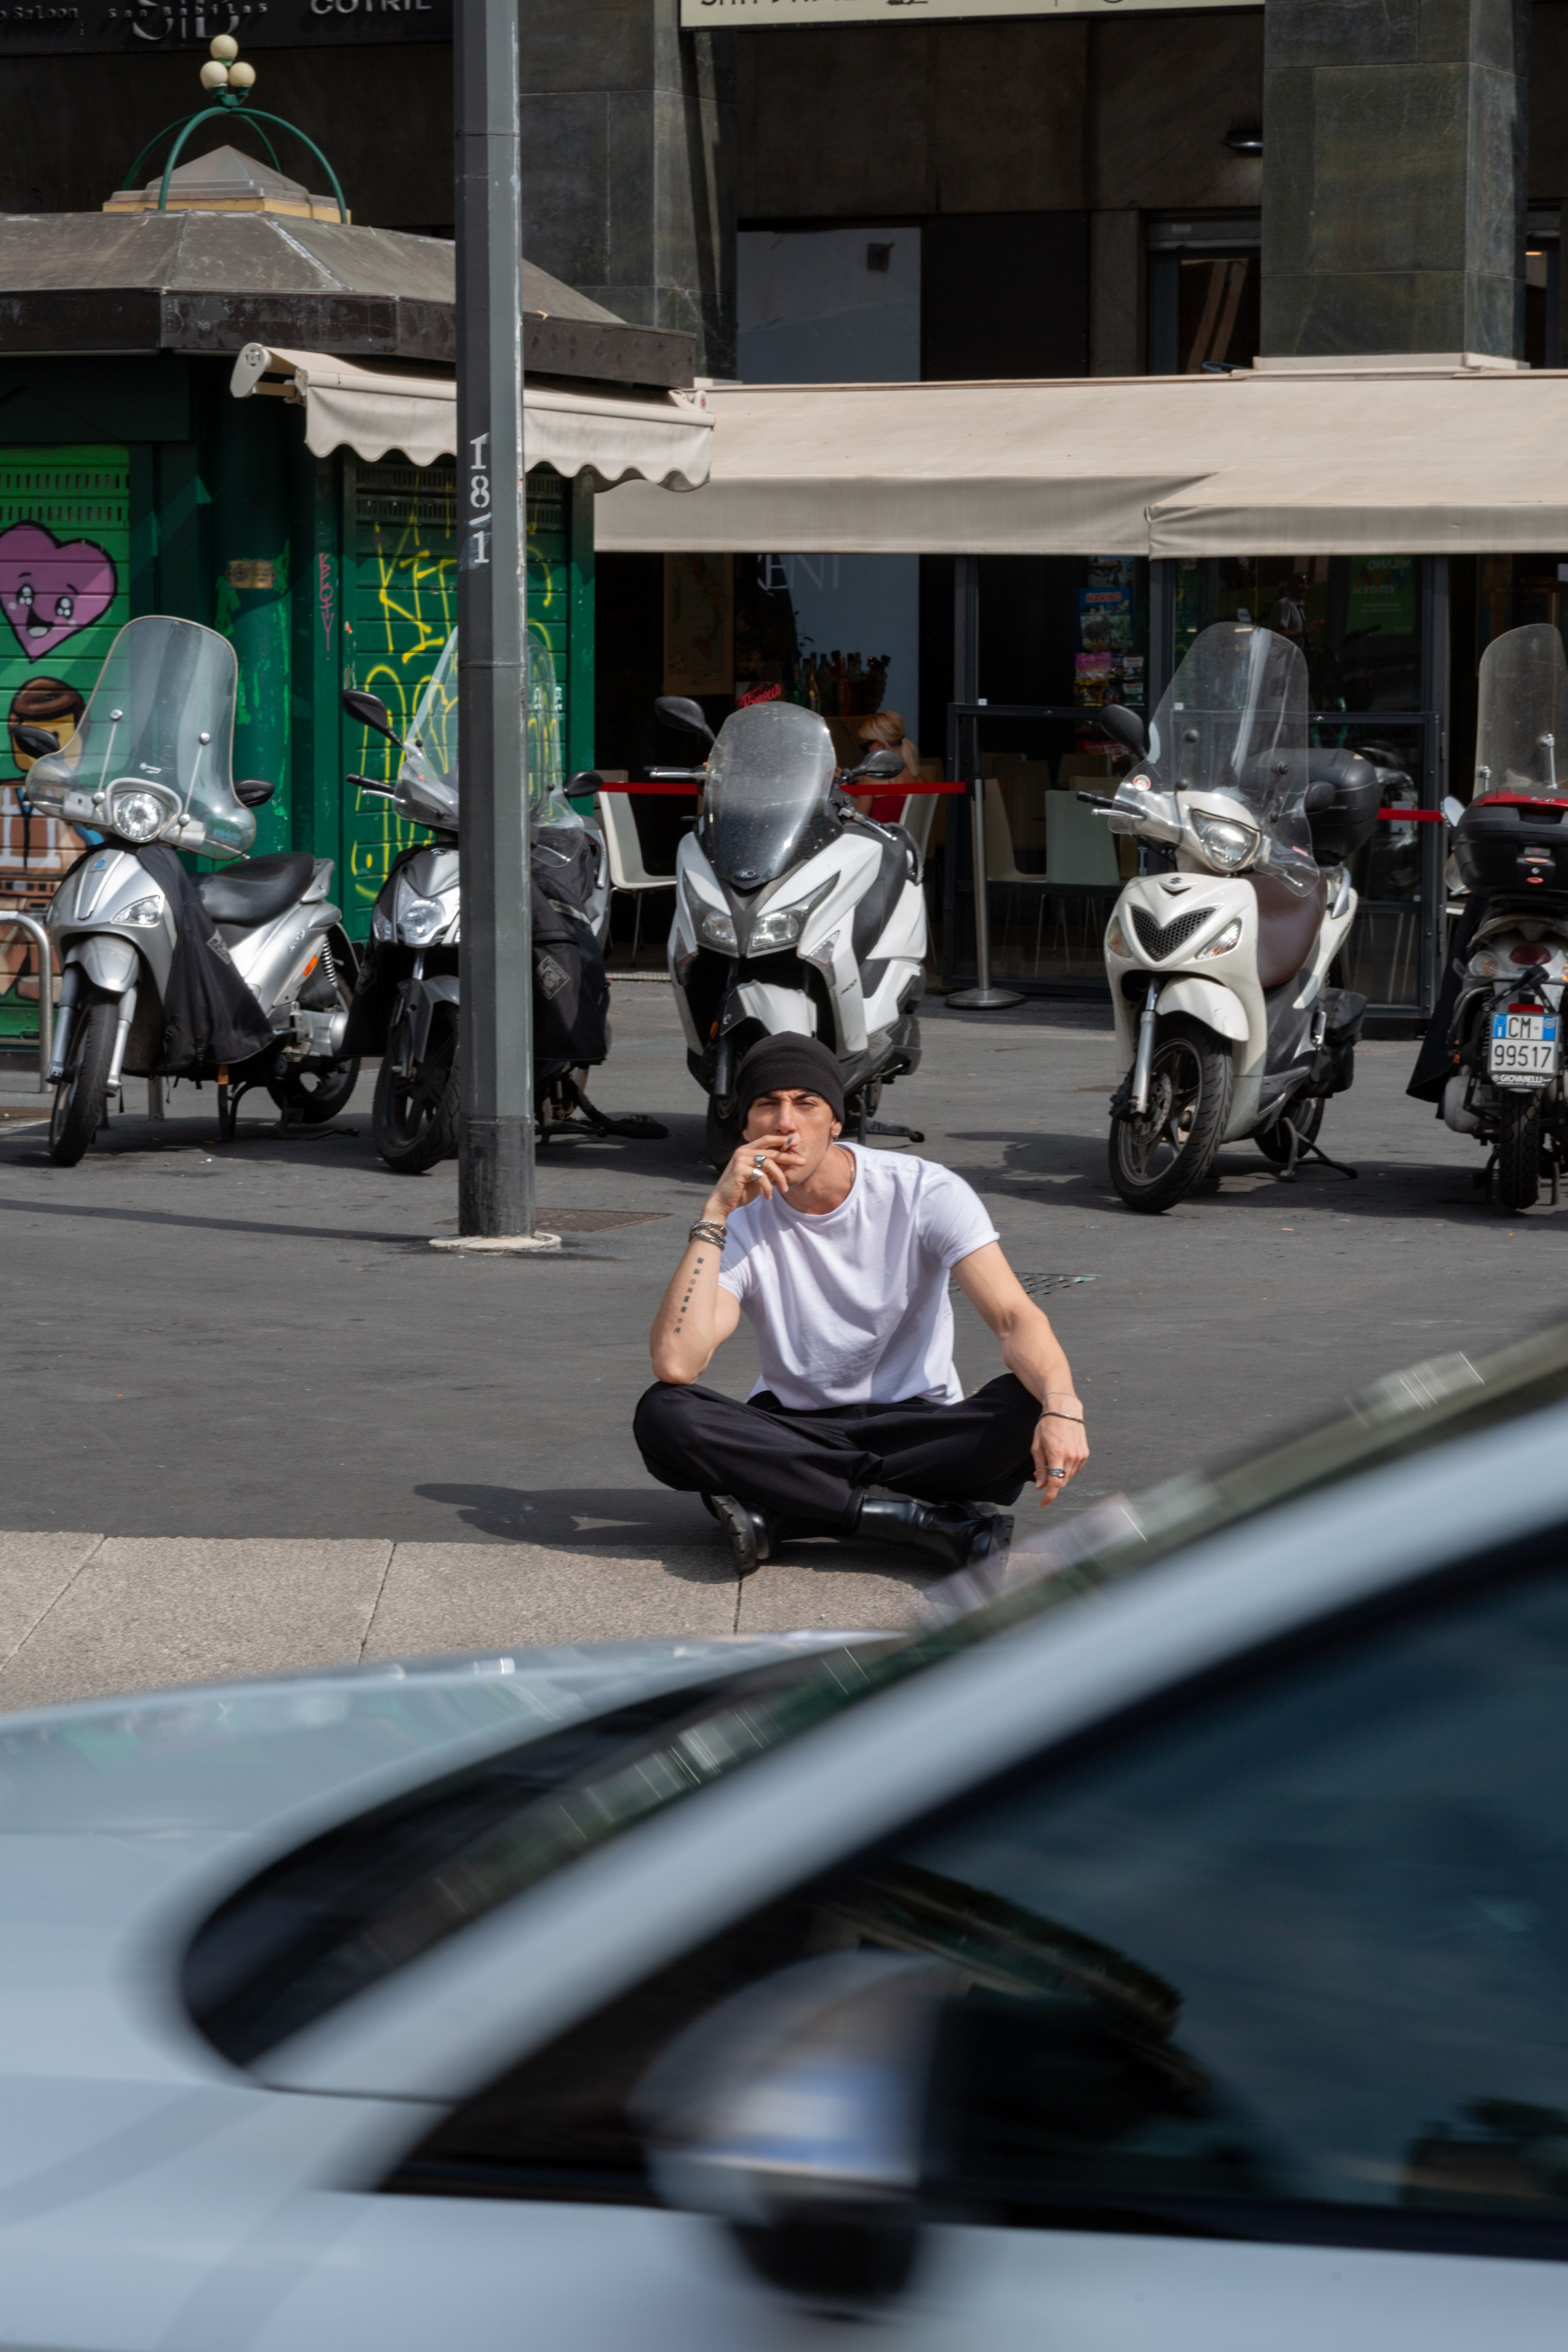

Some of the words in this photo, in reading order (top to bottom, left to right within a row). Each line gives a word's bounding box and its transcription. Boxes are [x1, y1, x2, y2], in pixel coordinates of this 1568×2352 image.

[12, 5, 79, 20] Saloon
[1086, 592, 1123, 603] HARIBO
[1509, 1017, 1531, 1038] CM
[1494, 1044, 1552, 1068] 99517
[1499, 1074, 1544, 1084] GIOVANELLI
